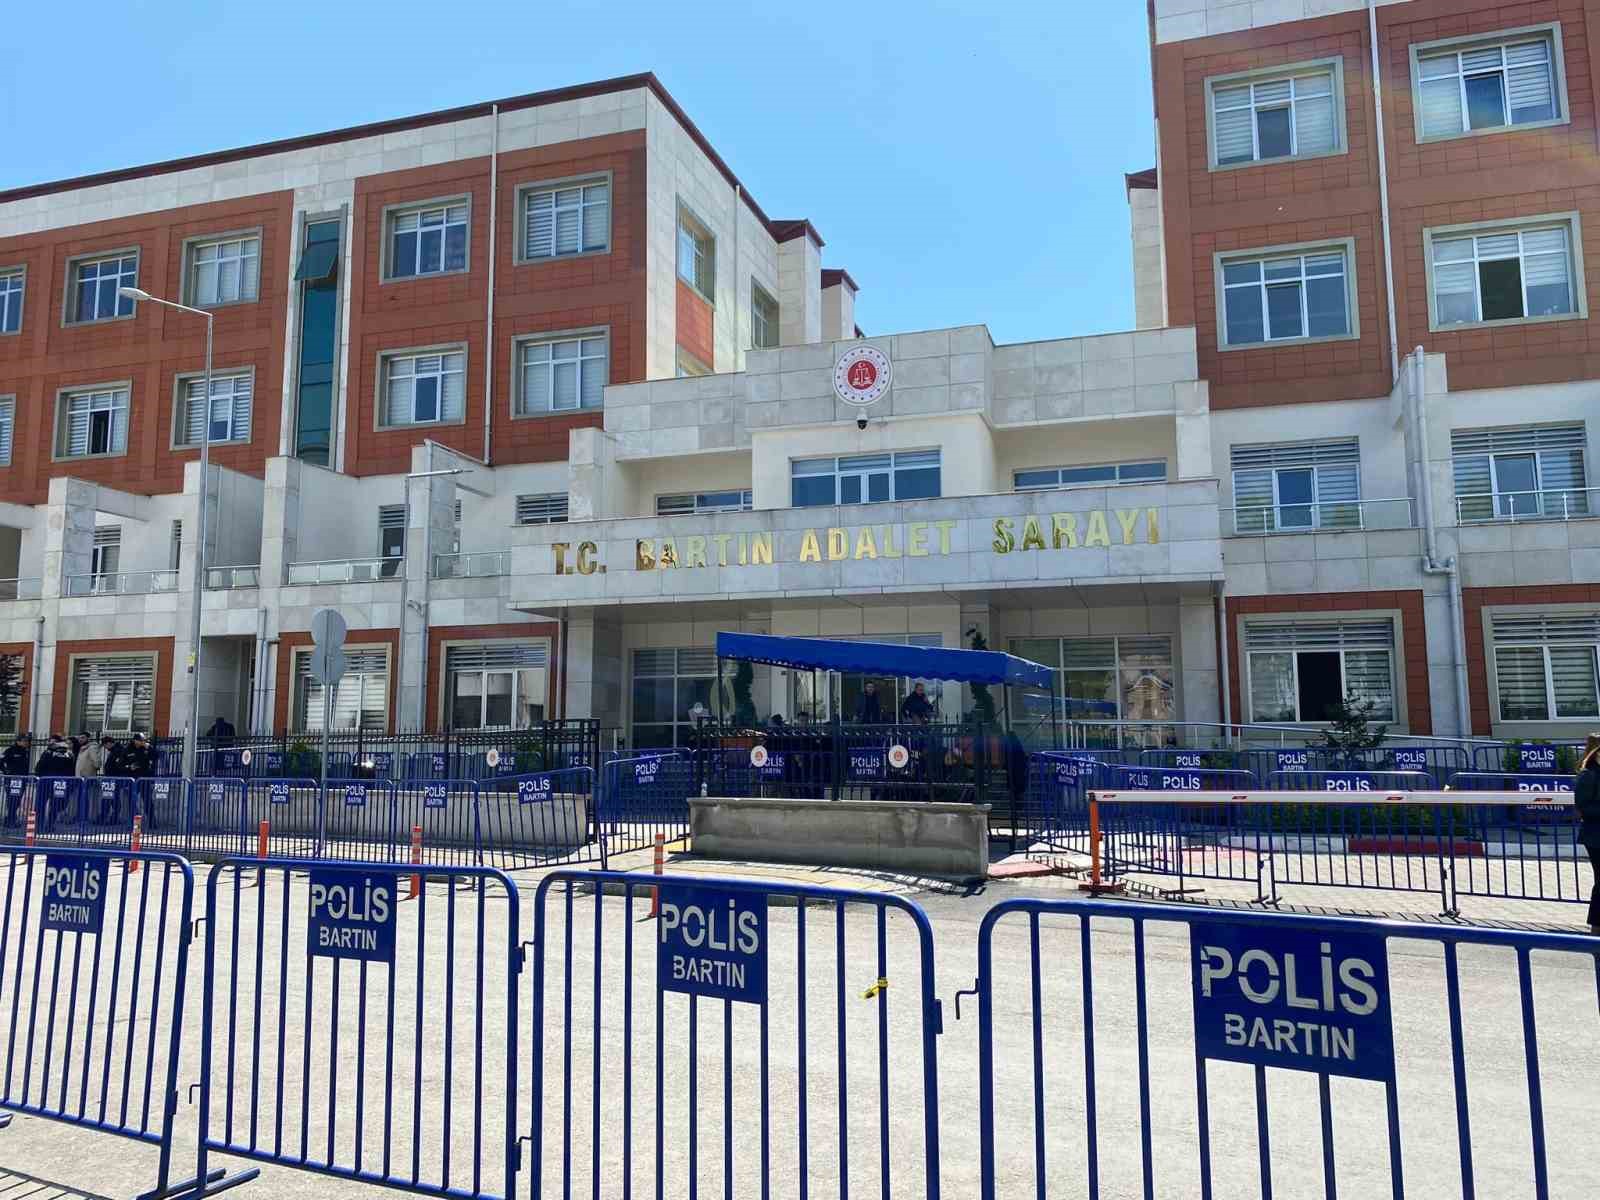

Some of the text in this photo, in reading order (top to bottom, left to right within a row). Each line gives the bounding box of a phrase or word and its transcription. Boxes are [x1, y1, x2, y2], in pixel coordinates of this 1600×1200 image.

[551, 506, 1160, 575] T.C. BARTIN ADALET SARAYI
[1176, 754, 1201, 766] POLİS
[1278, 752, 1307, 764] POLİS
[1395, 750, 1426, 762] POLİS
[1521, 748, 1555, 761] POLİS
[635, 760, 657, 776] POLİS
[270, 782, 289, 794] POLİS
[345, 784, 366, 796] POLİS
[518, 777, 551, 793] POLİS
[1162, 774, 1201, 790] POLİS
[1326, 777, 1370, 792] POLİS
[424, 784, 446, 798] POLİS
[44, 862, 100, 900] POLİS
[310, 879, 390, 922] POLİS
[48, 904, 90, 925] BARTIN
[661, 899, 760, 954] POLİS
[319, 926, 377, 951] BARTIN
[673, 955, 745, 989] BARTIN
[1200, 942, 1378, 1016] POLİS
[1224, 1013, 1356, 1060] BARTIN
